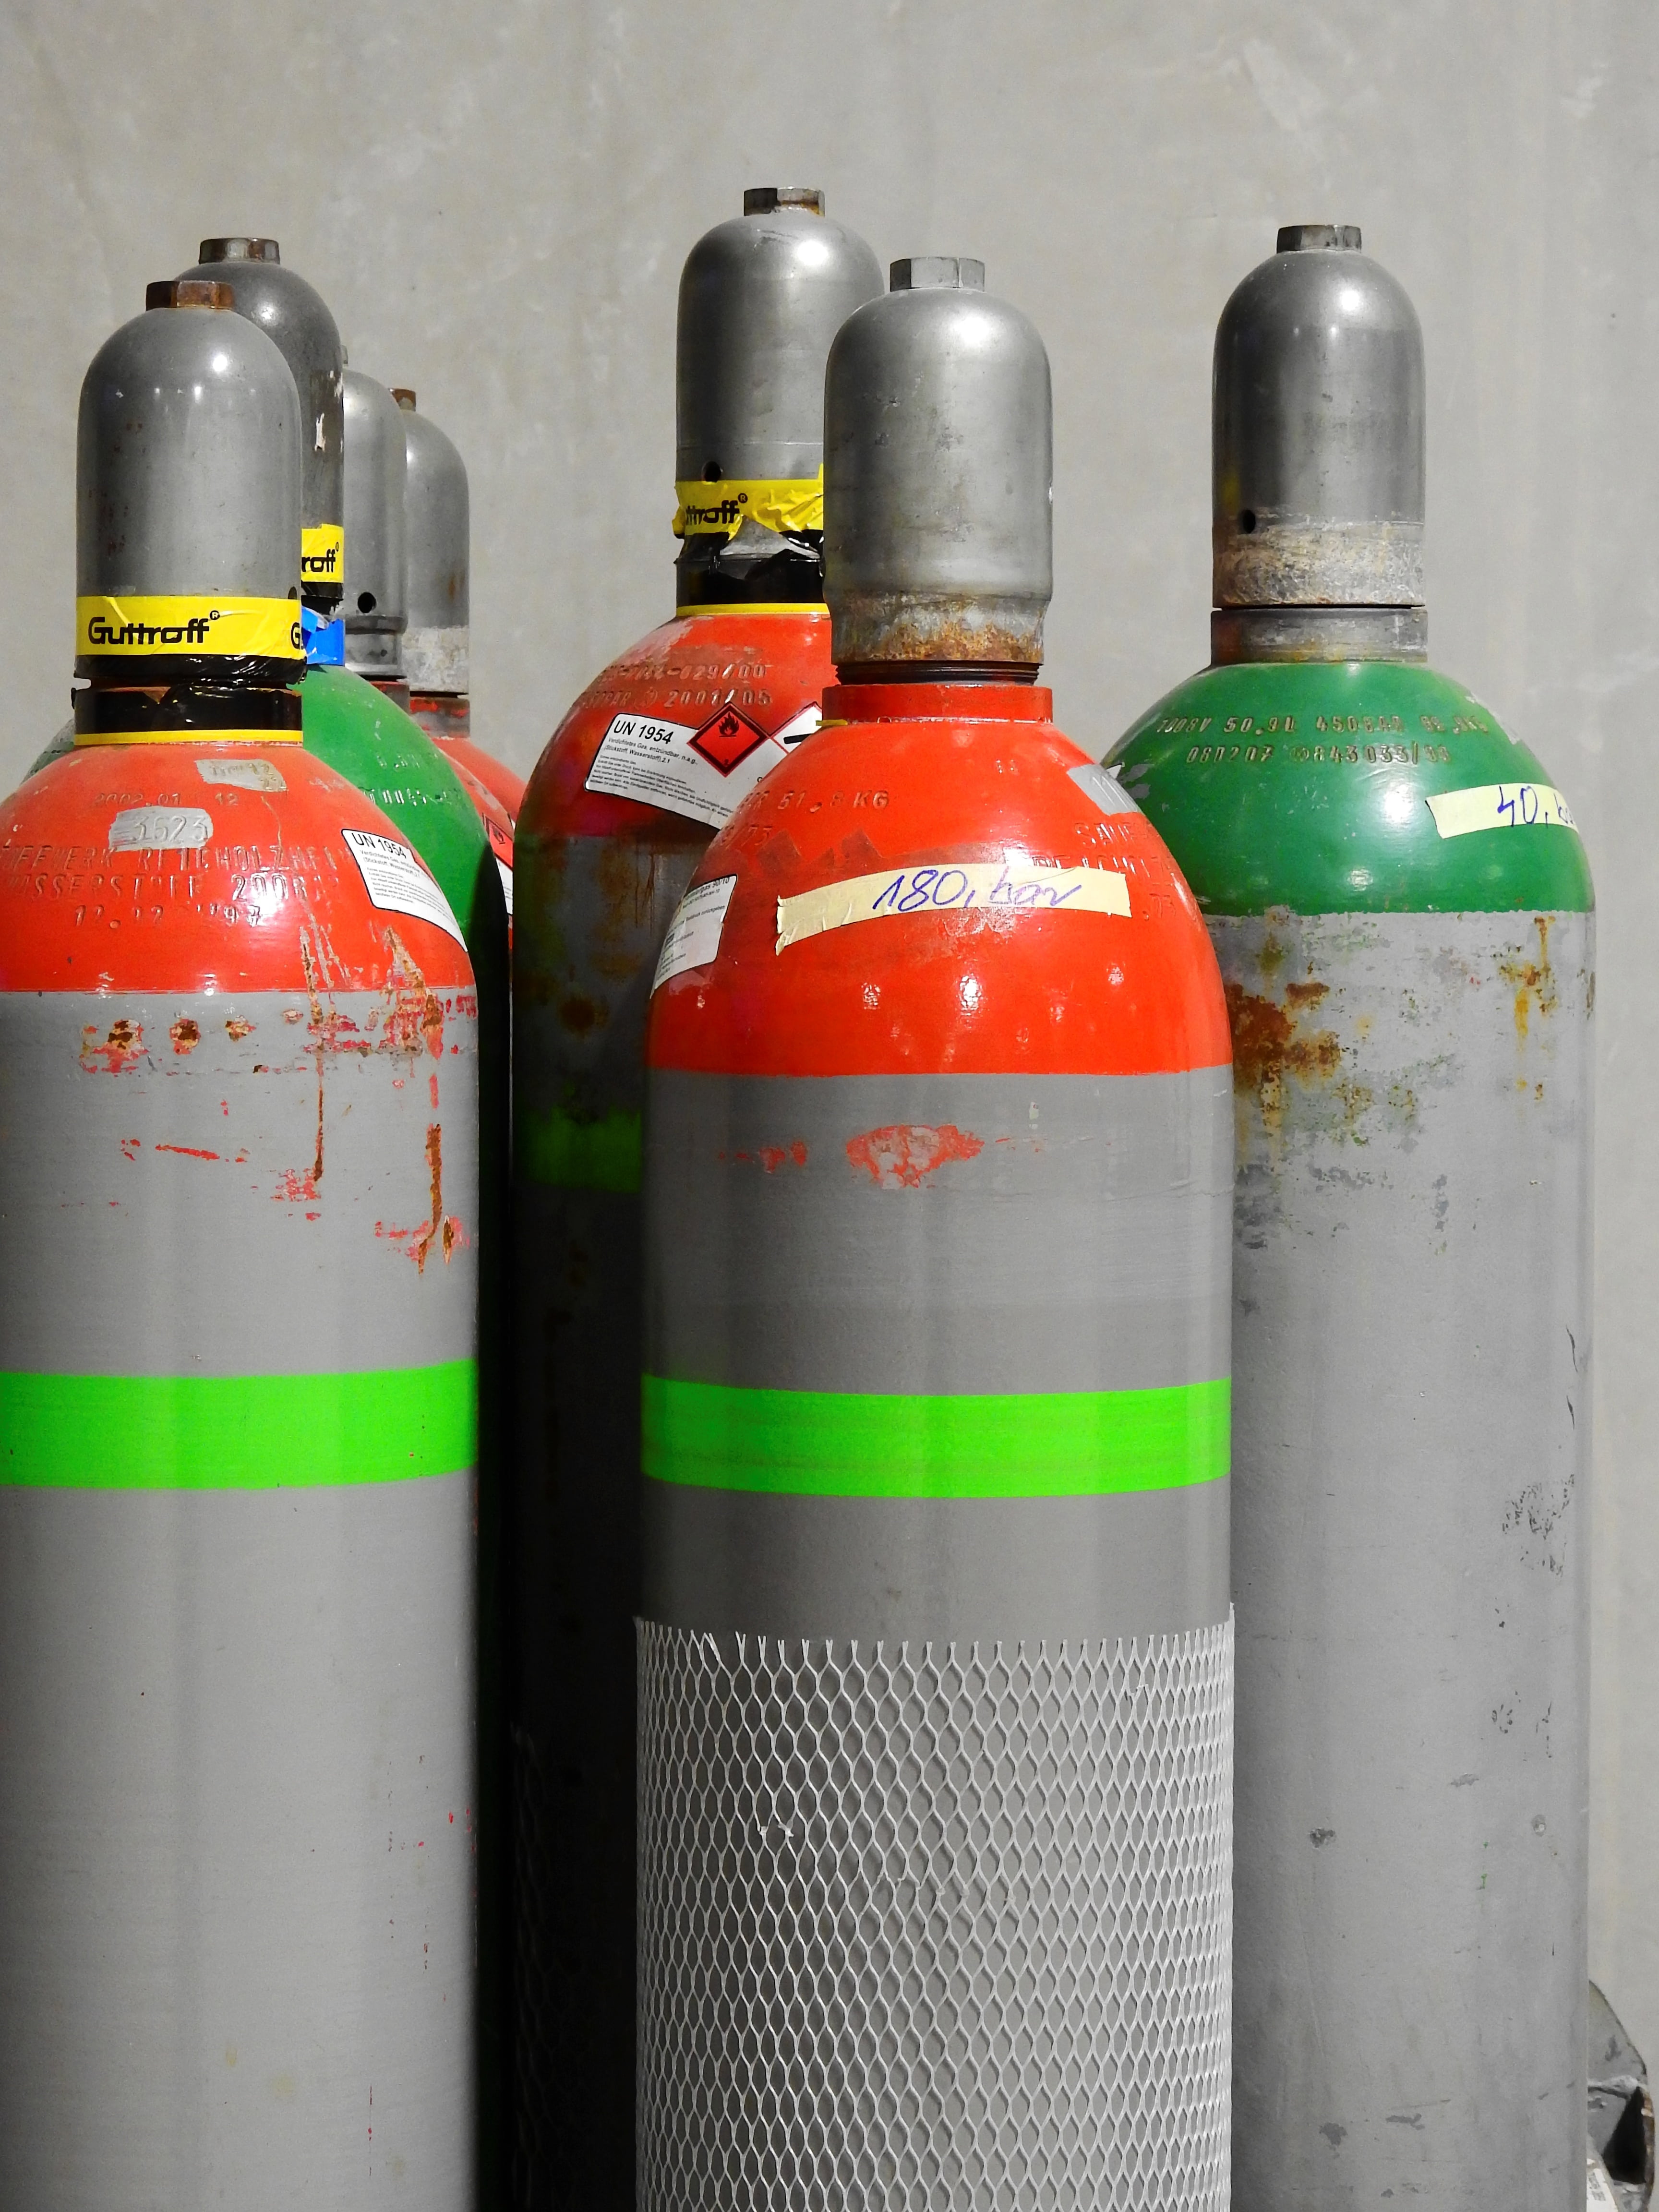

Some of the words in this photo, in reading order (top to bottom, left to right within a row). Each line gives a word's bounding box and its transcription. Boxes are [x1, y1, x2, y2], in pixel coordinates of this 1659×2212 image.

[613, 720, 636, 735] UN
[638, 725, 674, 744] 1954
[351, 832, 376, 849] UN
[378, 838, 407, 859] 1954
